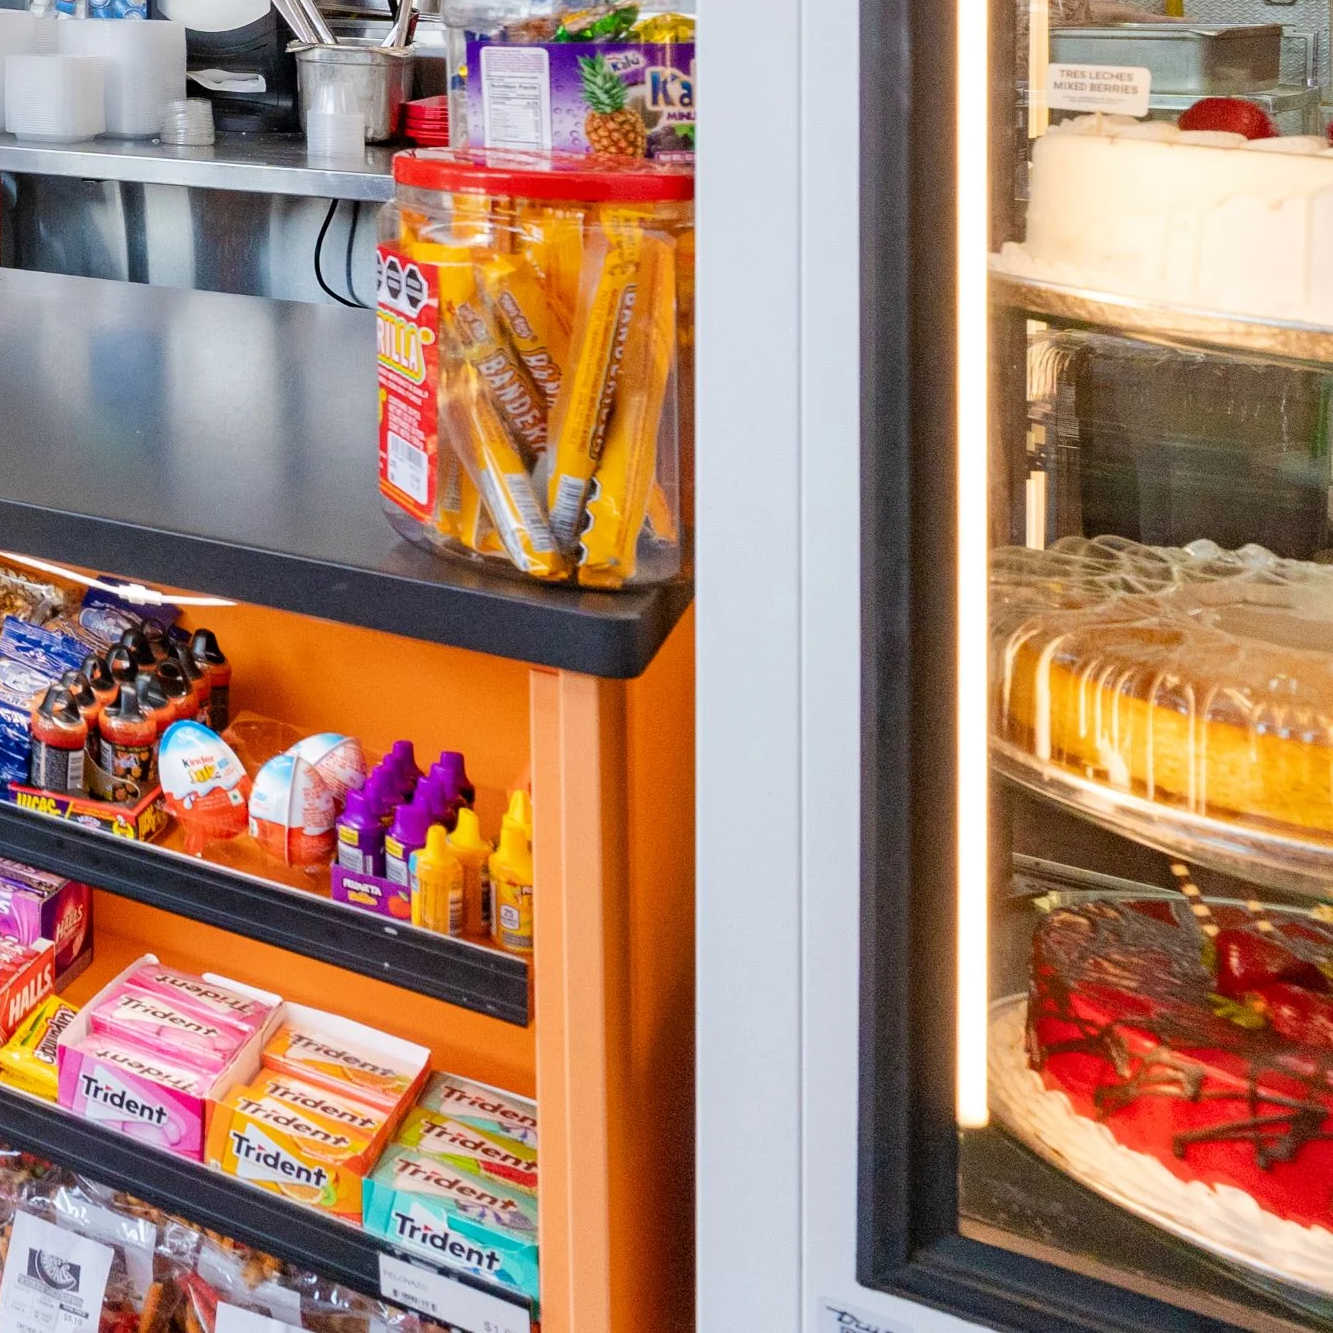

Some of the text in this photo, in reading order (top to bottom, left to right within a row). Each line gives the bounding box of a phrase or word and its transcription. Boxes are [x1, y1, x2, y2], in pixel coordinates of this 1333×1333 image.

[1053, 81, 1140, 95] MIXED BERRIES
[1058, 69, 1134, 82] TRES LECHES
[181, 754, 215, 767] Kinder
[8, 962, 53, 1027] HALLS
[117, 995, 218, 1038] Trident
[155, 974, 255, 1016] Trident
[95, 1049, 199, 1095] Trident
[290, 1032, 396, 1079] Trident
[81, 1074, 168, 1127] Trident
[237, 1097, 351, 1148] Trident
[265, 1082, 379, 1131] Trident
[441, 1085, 537, 1127] Triden
[231, 1131, 330, 1188] Trident
[394, 1159, 518, 1211] Trident
[394, 1211, 500, 1272] Trident
[382, 1268, 428, 1294] PELONAZO
